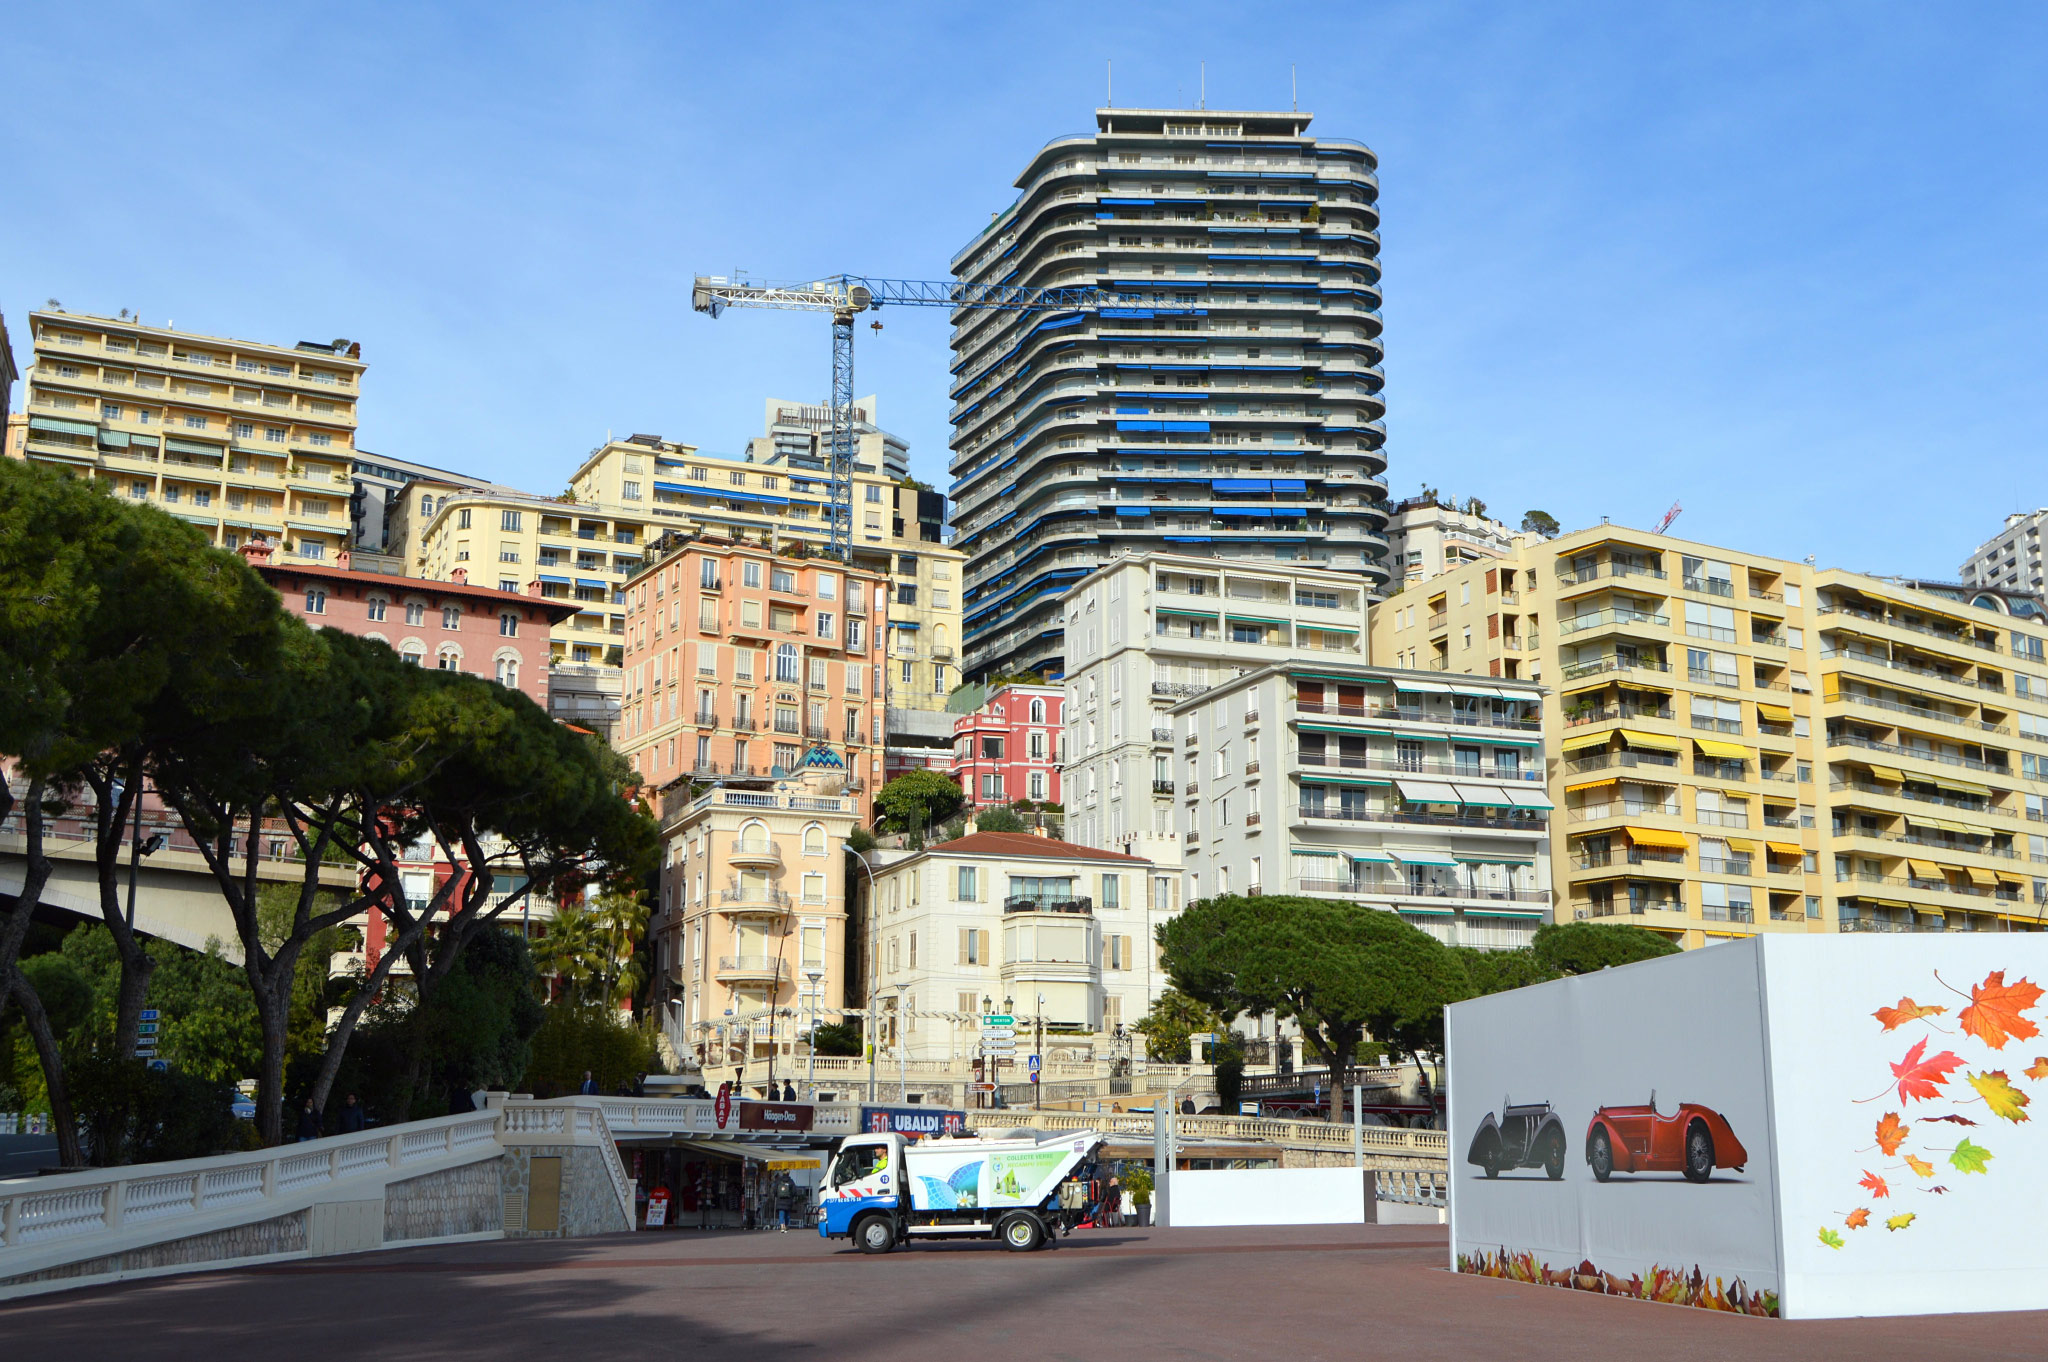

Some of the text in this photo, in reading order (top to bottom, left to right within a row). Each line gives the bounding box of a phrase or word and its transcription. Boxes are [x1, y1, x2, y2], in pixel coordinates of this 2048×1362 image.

[718, 1089, 727, 1123] TABAC
[763, 1109, 797, 1123] Häagen-Dazs
[895, 1115, 939, 1131] UBALDI
